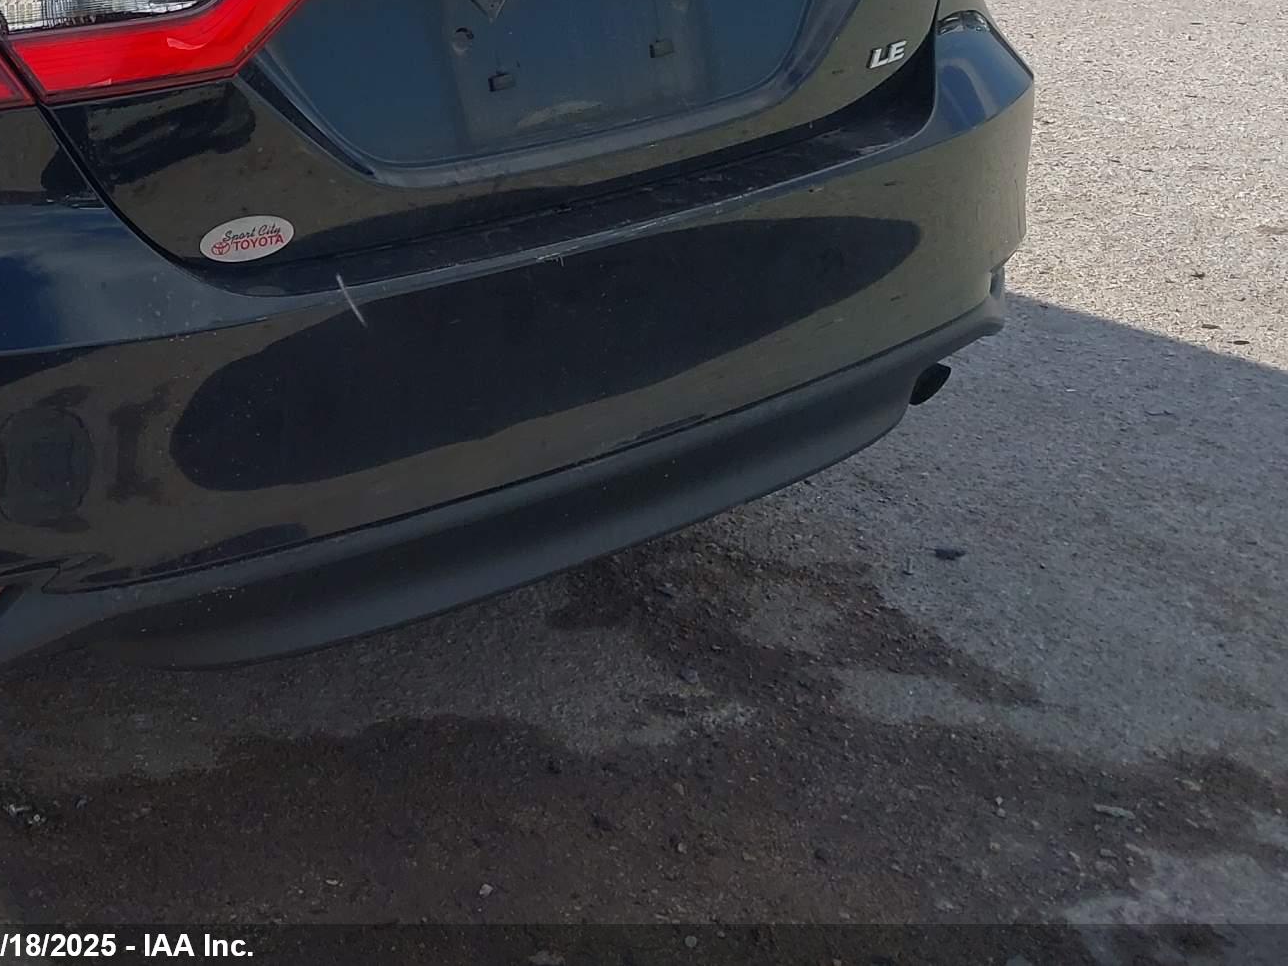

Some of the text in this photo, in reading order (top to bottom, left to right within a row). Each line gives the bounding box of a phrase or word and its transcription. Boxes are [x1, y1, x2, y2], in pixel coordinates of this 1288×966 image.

[867, 39, 908, 69] LE
[223, 224, 281, 245] Sport City
[232, 234, 285, 251] TOYOTA
